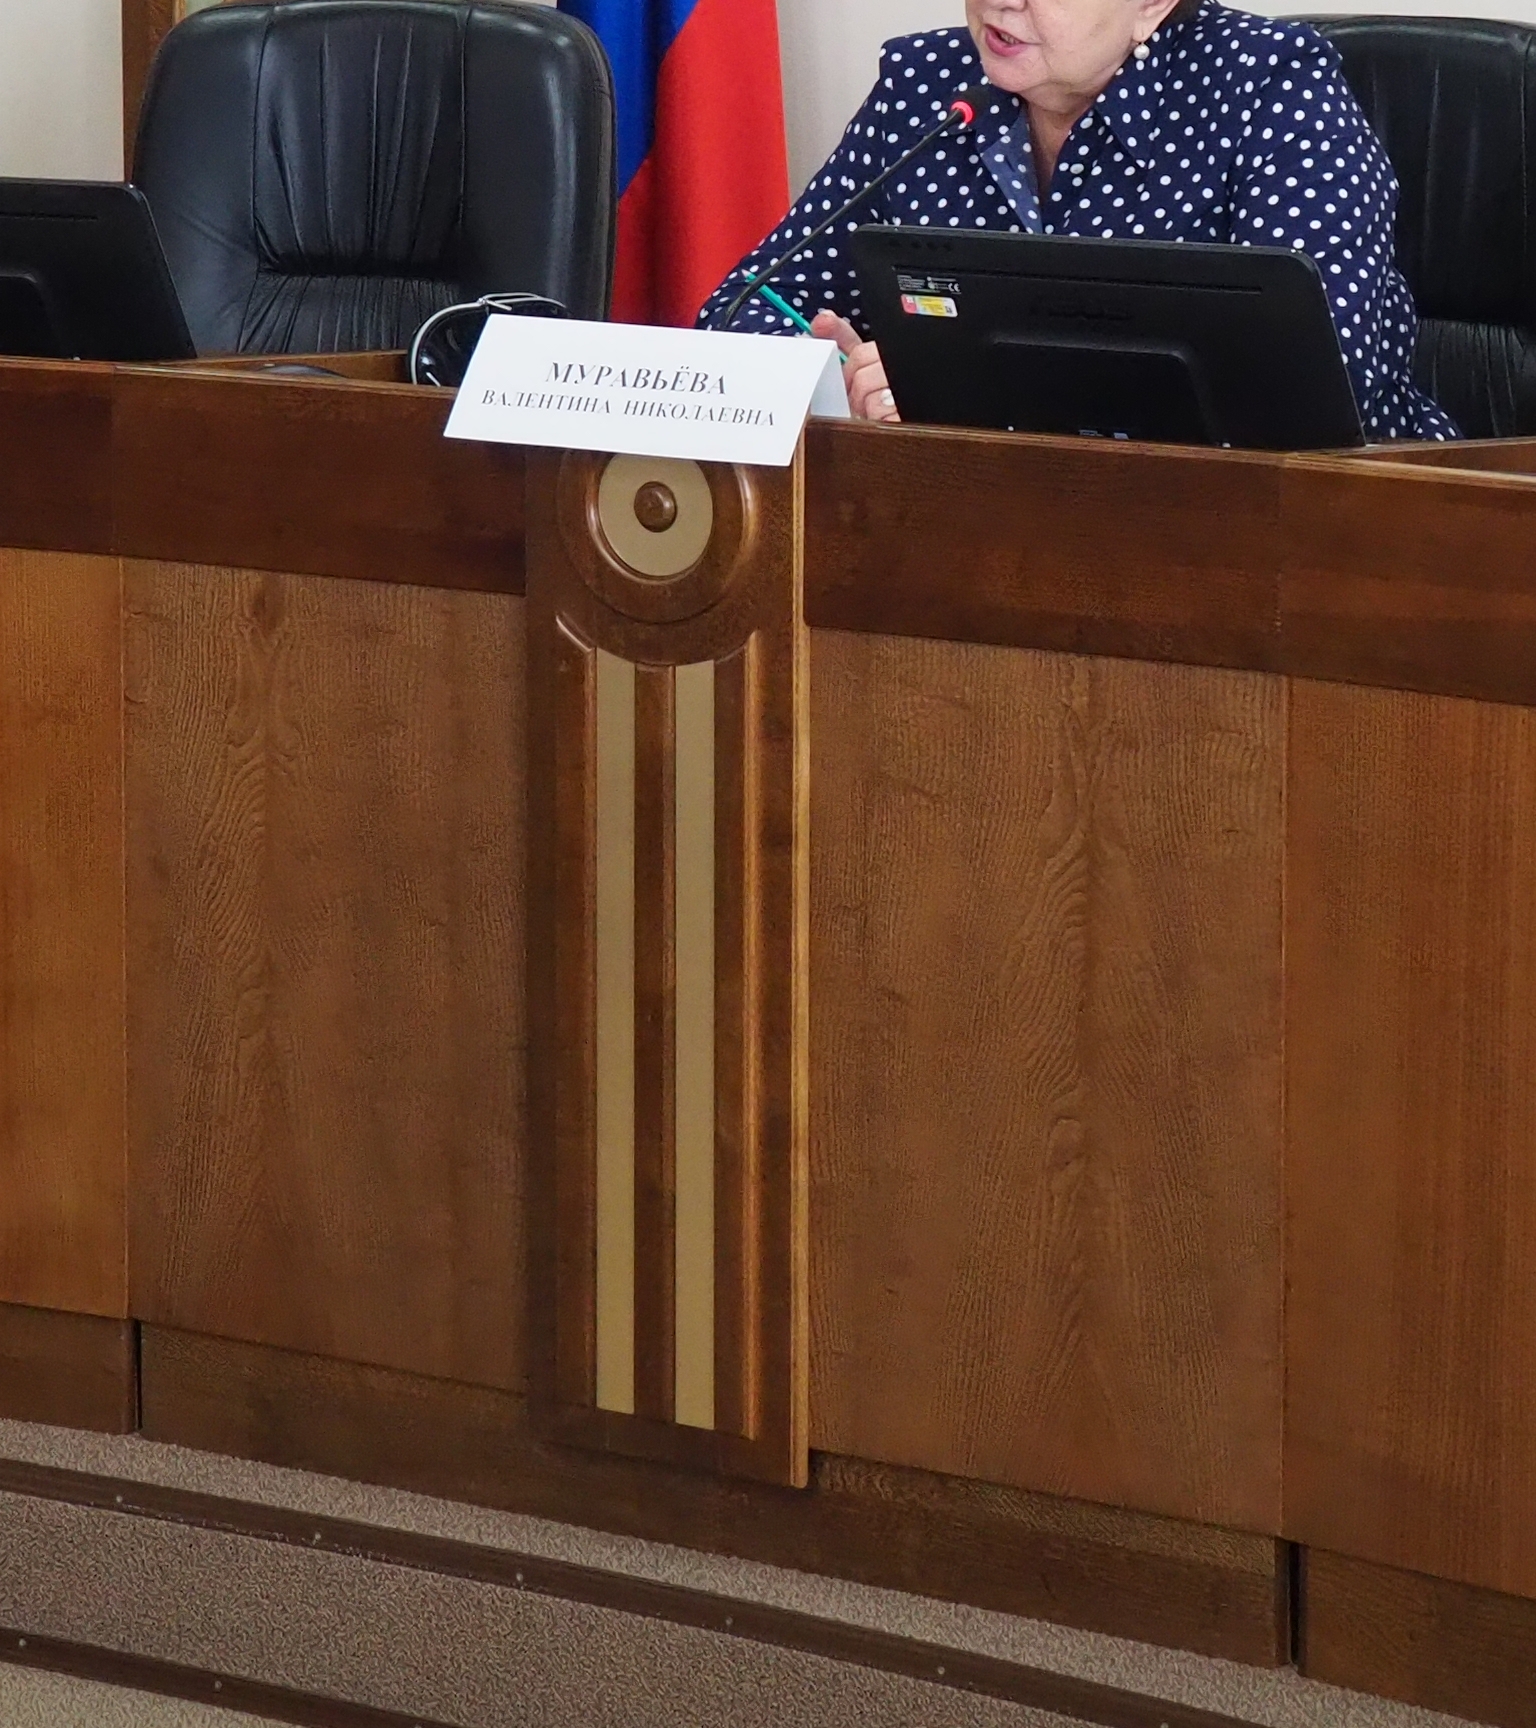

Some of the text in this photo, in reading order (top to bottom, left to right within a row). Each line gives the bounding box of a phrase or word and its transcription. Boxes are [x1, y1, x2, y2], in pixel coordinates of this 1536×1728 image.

[545, 361, 727, 396] МУРАВЬЁВА
[481, 389, 776, 427] ВАЛЕНТИНА НИКОЛАЕВНА
